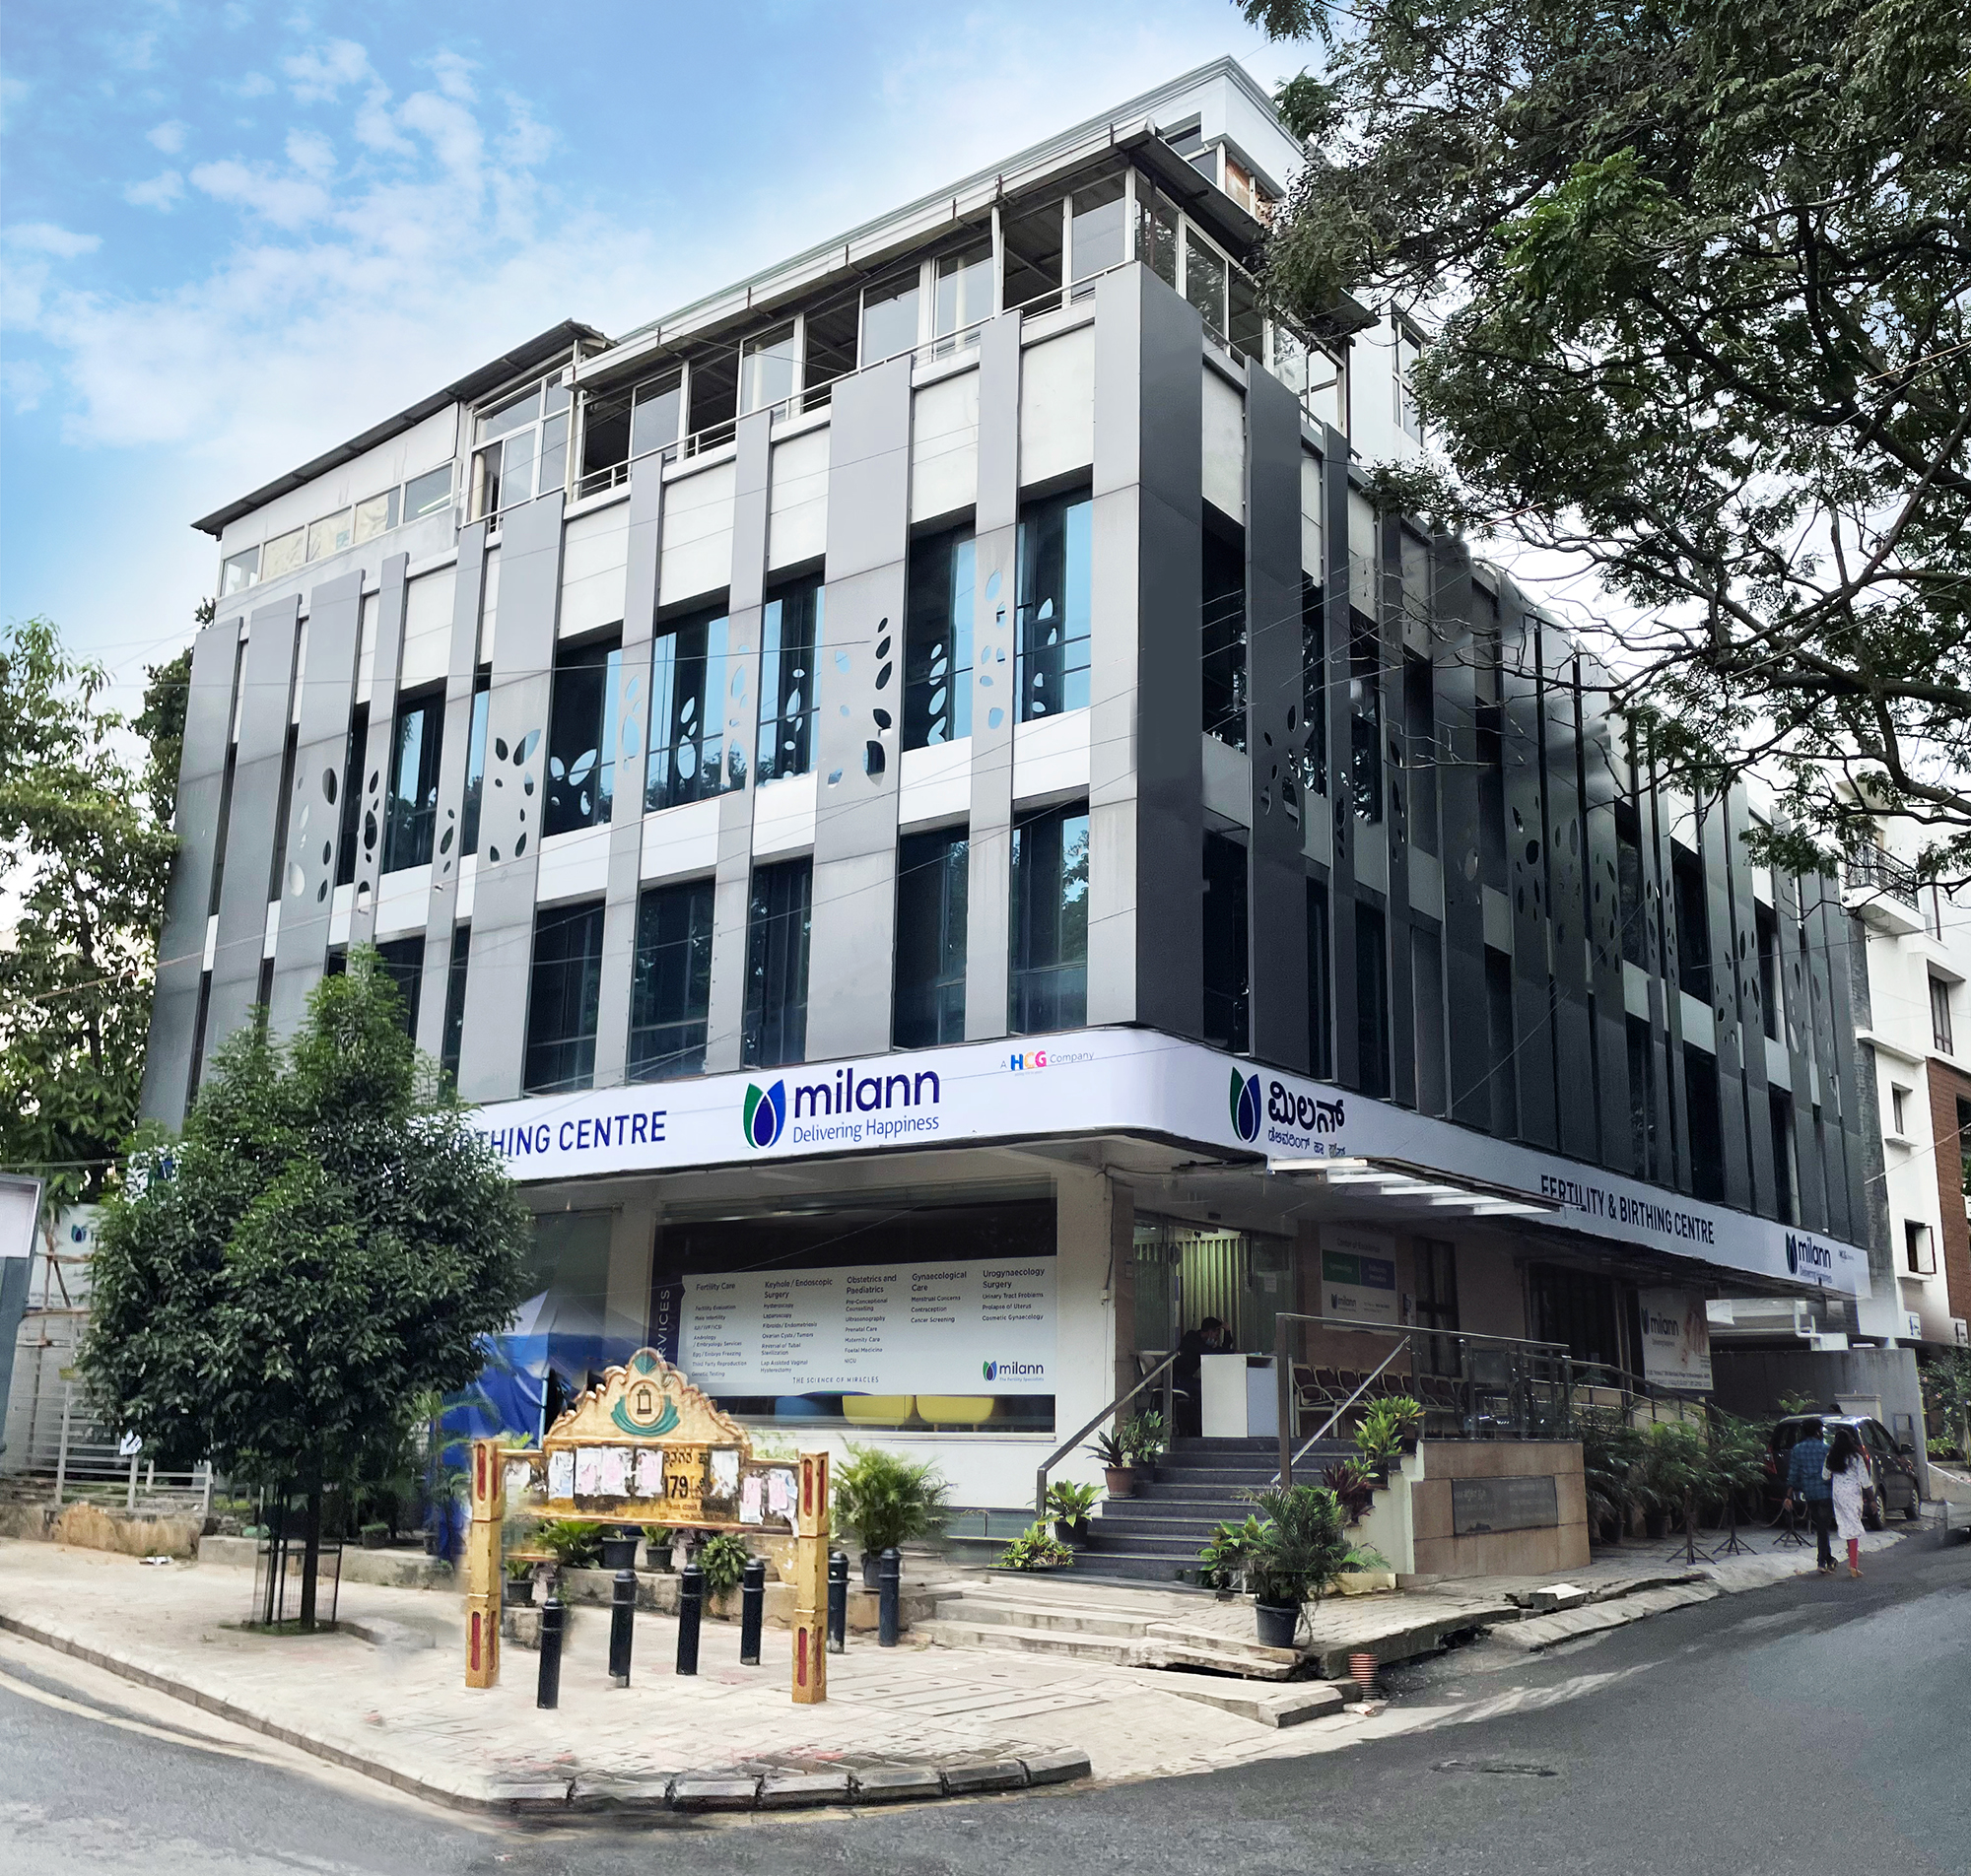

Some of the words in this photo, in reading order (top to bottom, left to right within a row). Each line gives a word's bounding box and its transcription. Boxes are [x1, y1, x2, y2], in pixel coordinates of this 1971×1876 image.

[1011, 1050, 1047, 1070] HCG
[1050, 1051, 1094, 1063] Company
[794, 1067, 939, 1118] milann
[459, 1123, 551, 1159] THING
[559, 1109, 666, 1151] CENTRE
[793, 1122, 862, 1143] Delivering
[866, 1115, 939, 1139] Happiness
[1608, 1193, 1617, 1220] &
[1620, 1196, 1672, 1235] BIRTHING
[1675, 1212, 1714, 1244] CENTRE
[1798, 1236, 1831, 1269] milann
[913, 1271, 966, 1281] Gynaecological
[984, 1267, 1045, 1279] Urogynaecology
[696, 1282, 719, 1291] Fertility
[765, 1281, 789, 1290] Keyhole
[795, 1278, 833, 1287] Endoscopic
[764, 1291, 789, 1300] Surgery
[656, 1289, 670, 1358] RVICES
[999, 1362, 1044, 1374] milann
